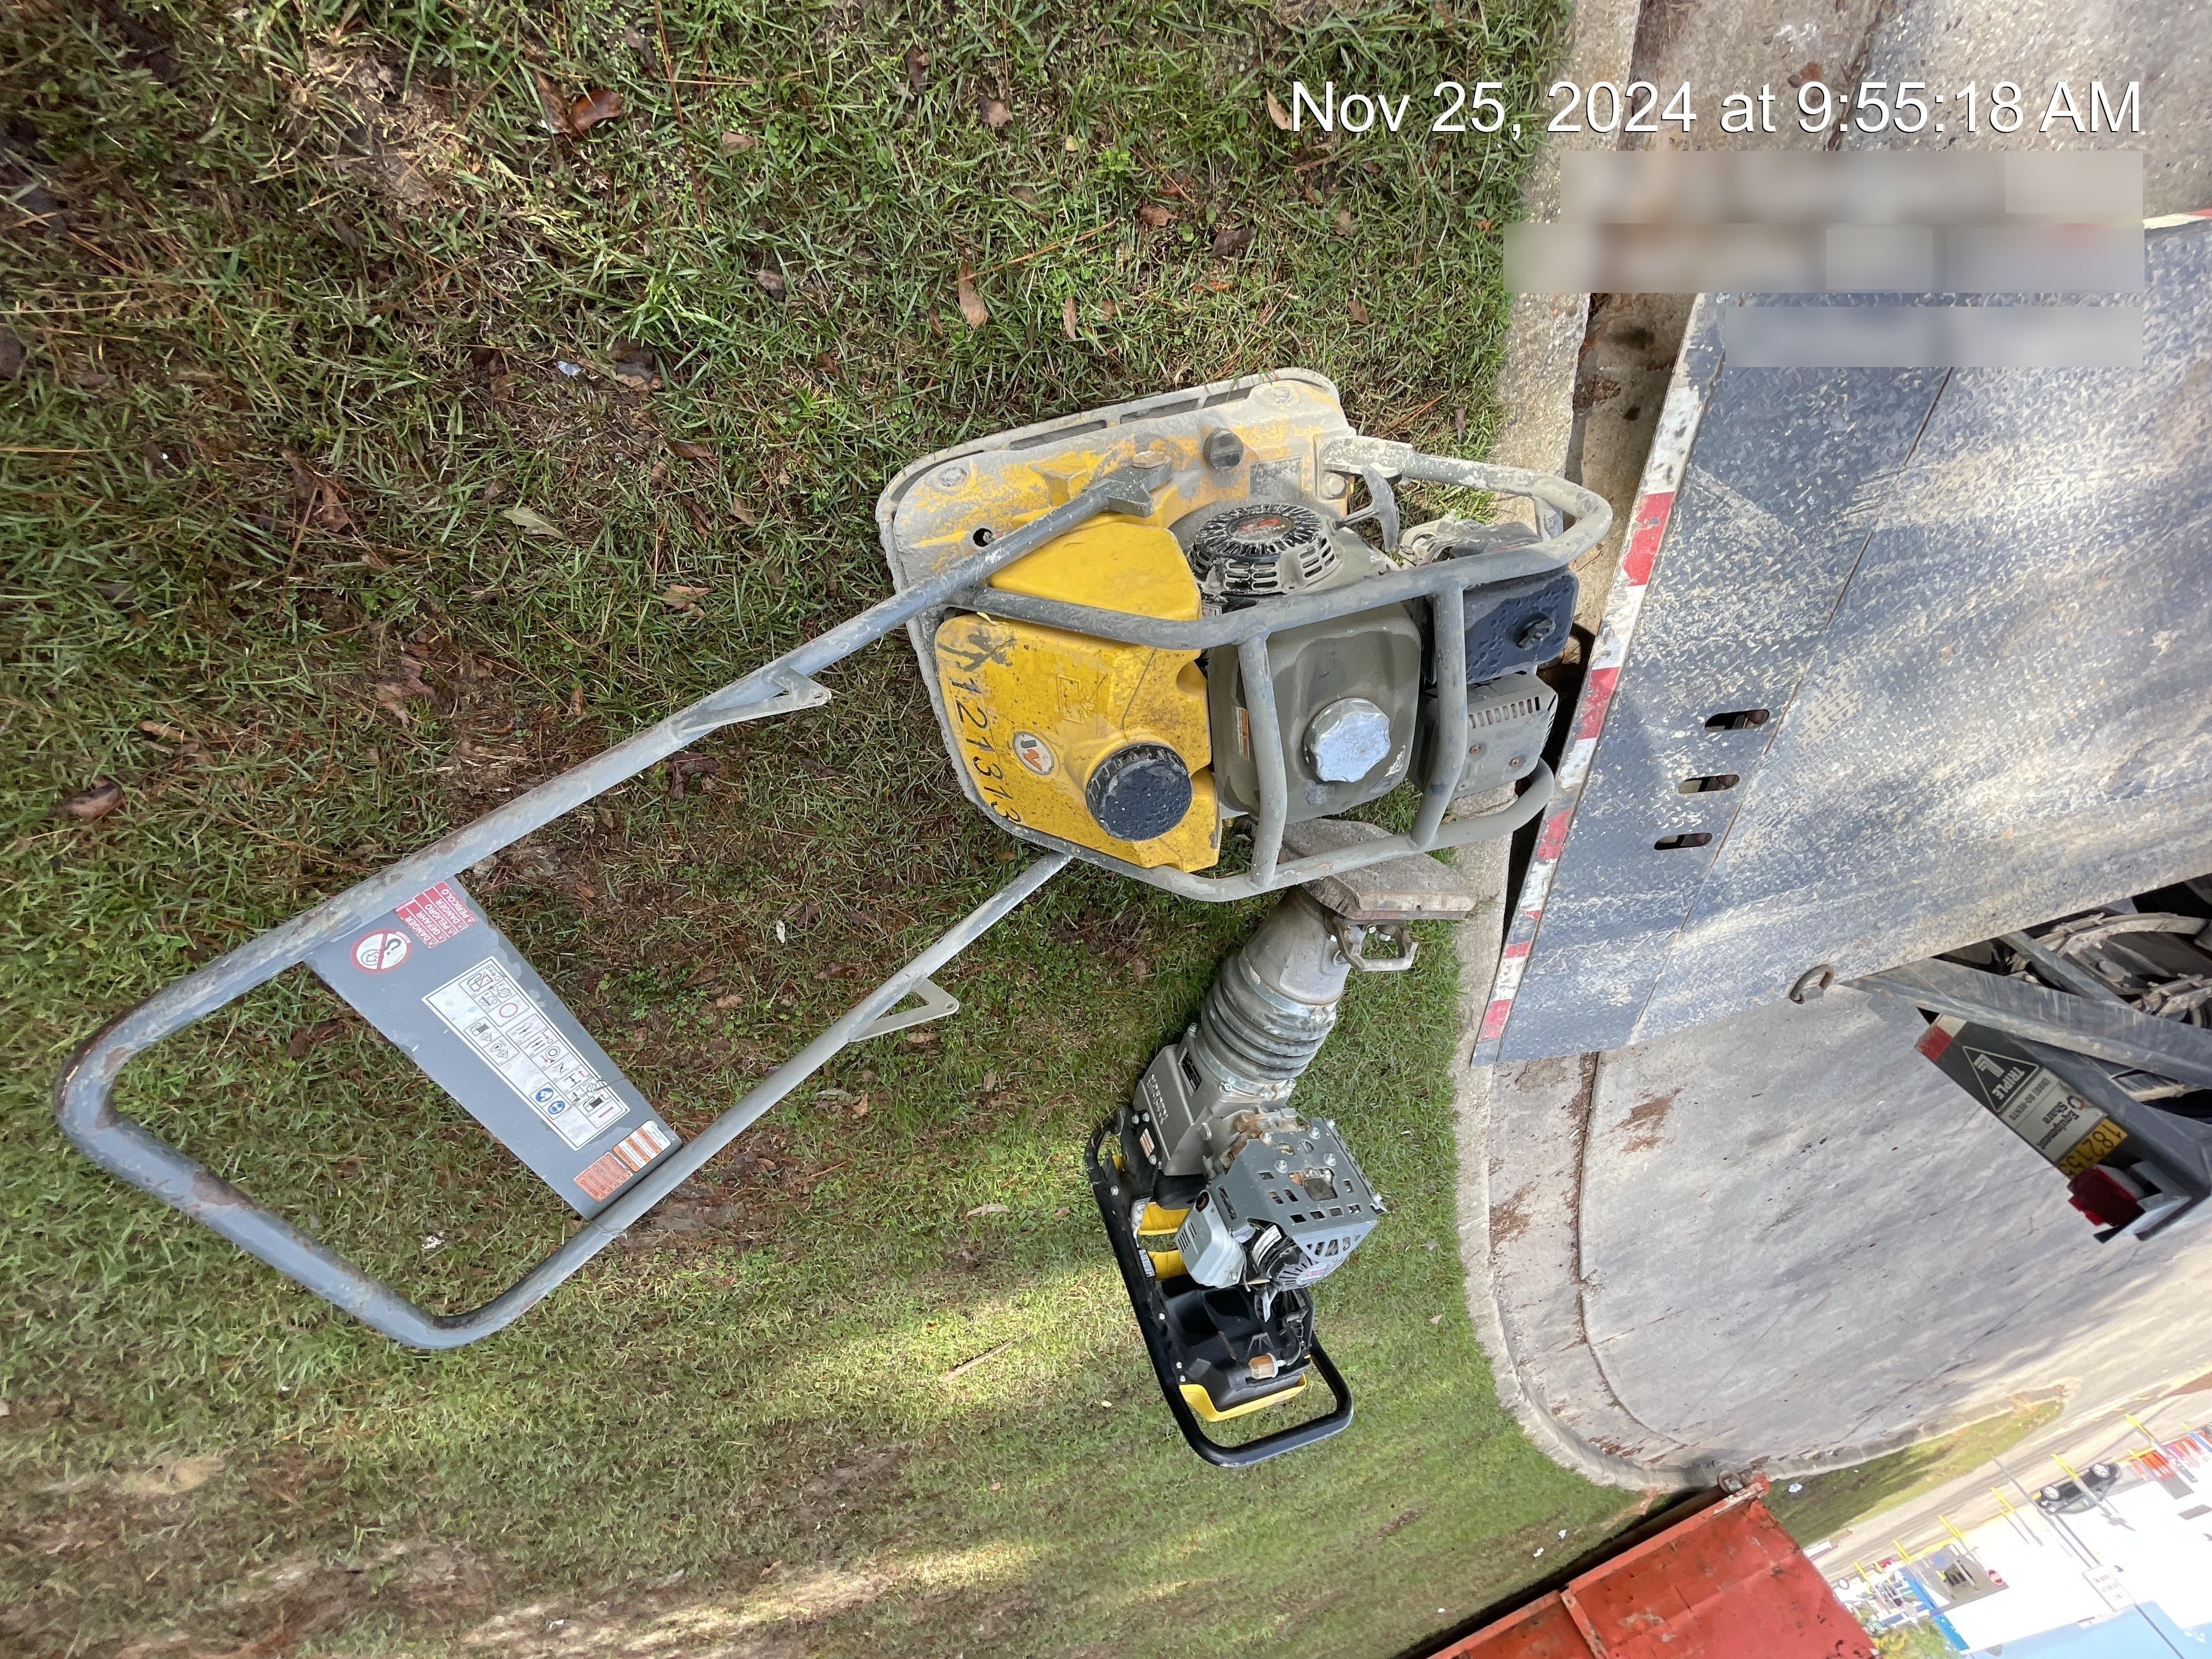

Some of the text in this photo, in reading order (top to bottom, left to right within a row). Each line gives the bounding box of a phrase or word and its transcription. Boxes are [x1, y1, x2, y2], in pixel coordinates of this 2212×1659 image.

[425, 903, 450, 930] PELIGRO
[435, 899, 459, 924] DANGER
[441, 888, 467, 919] PERICOLO
[405, 915, 430, 942] DANGER
[416, 910, 439, 935] GEFAHR
[1991, 1066, 2025, 1100] TRIPLE
[2042, 1101, 2068, 1124] Share
[2037, 1110, 2079, 1150] Equipment
